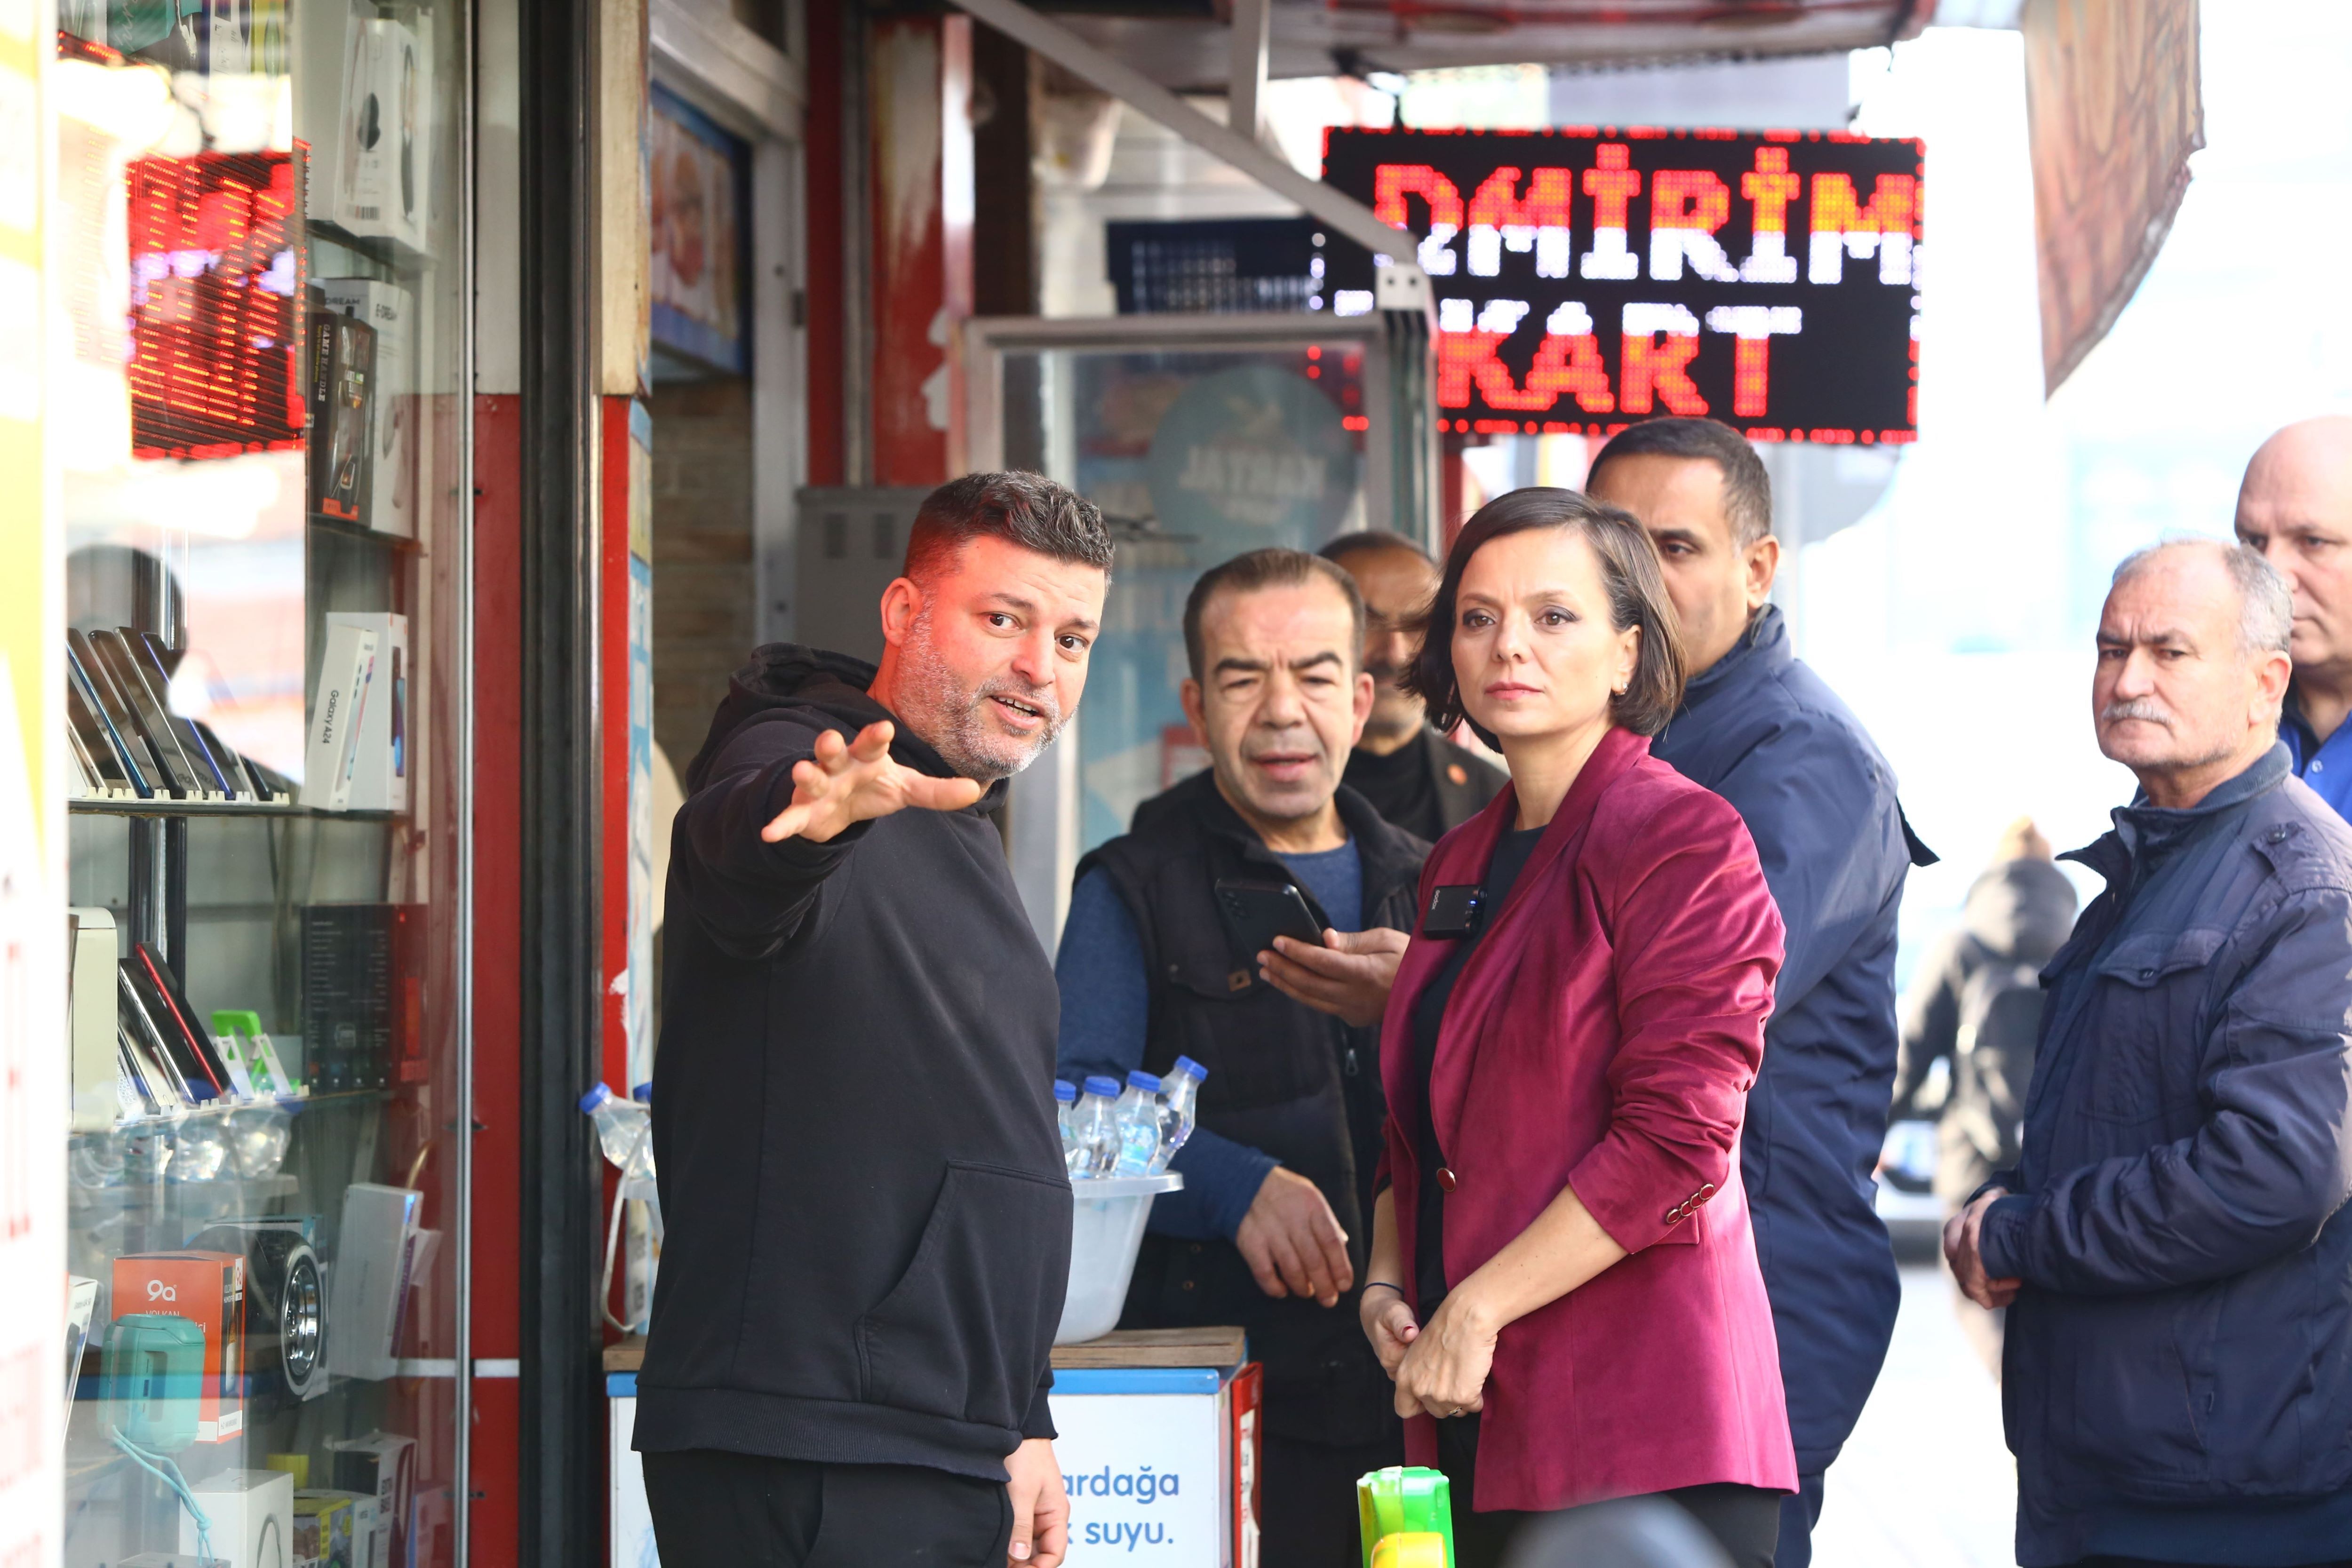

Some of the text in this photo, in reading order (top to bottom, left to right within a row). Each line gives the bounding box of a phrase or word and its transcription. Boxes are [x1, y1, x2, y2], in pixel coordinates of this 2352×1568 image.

[1437, 299, 1802, 416] KART
[322, 690, 339, 744] Galaxy A24
[1085, 1522, 1173, 1552] suyu.
